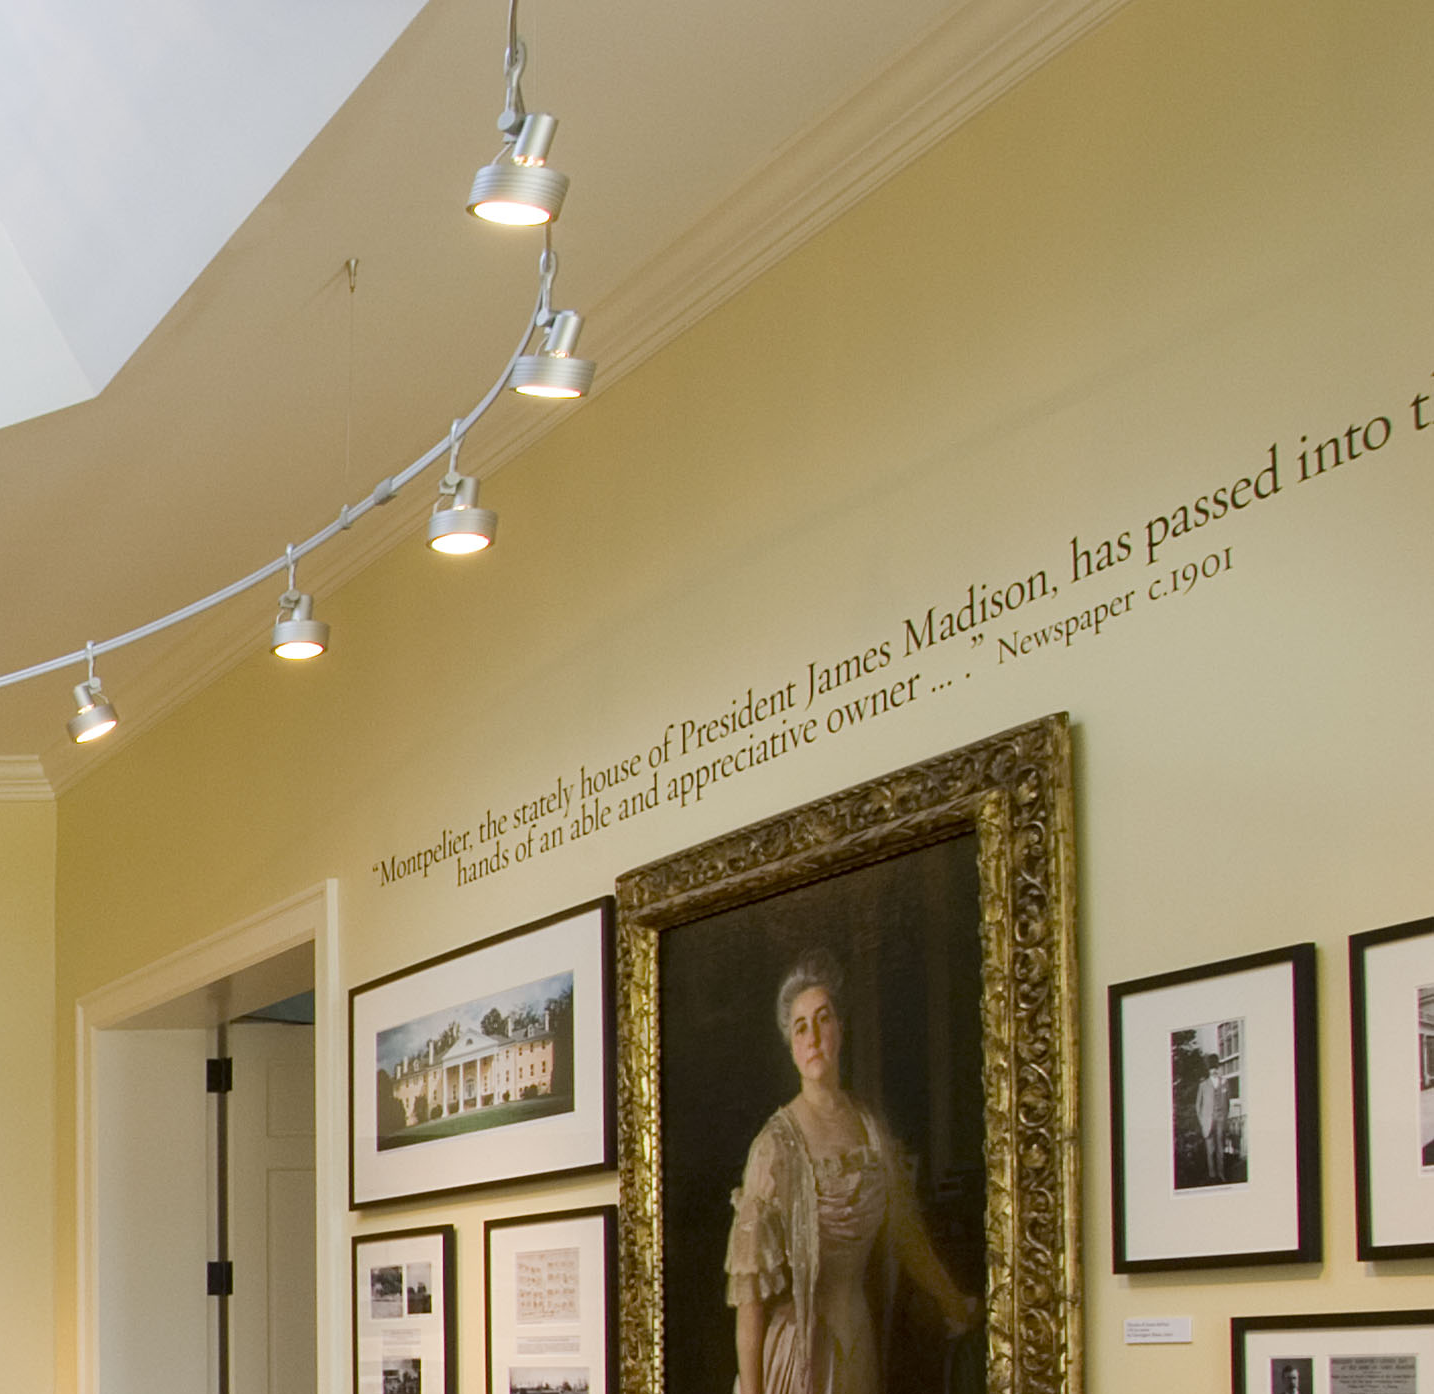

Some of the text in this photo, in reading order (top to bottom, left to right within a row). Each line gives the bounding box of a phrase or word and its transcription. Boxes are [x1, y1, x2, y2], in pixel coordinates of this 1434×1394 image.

[373, 830, 473, 886] “Montpelier,
[479, 810, 507, 843] the
[514, 777, 574, 829] stately
[581, 755, 641, 799] house
[649, 724, 674, 768] of
[681, 683, 796, 755] President
[805, 640, 891, 710] James
[903, 585, 1059, 657] Madison,
[1070, 531, 1131, 583] has
[1145, 443, 1283, 566] passed
[1297, 416, 1391, 483] into
[457, 841, 509, 887] hands
[515, 829, 534, 862] of
[540, 827, 563, 853] an
[570, 797, 611, 840] able
[618, 771, 659, 821] and
[667, 719, 817, 808] appreciative
[827, 672, 921, 733] owner
[998, 590, 1135, 664] Newspaper
[1148, 547, 1233, 600] c.1901
